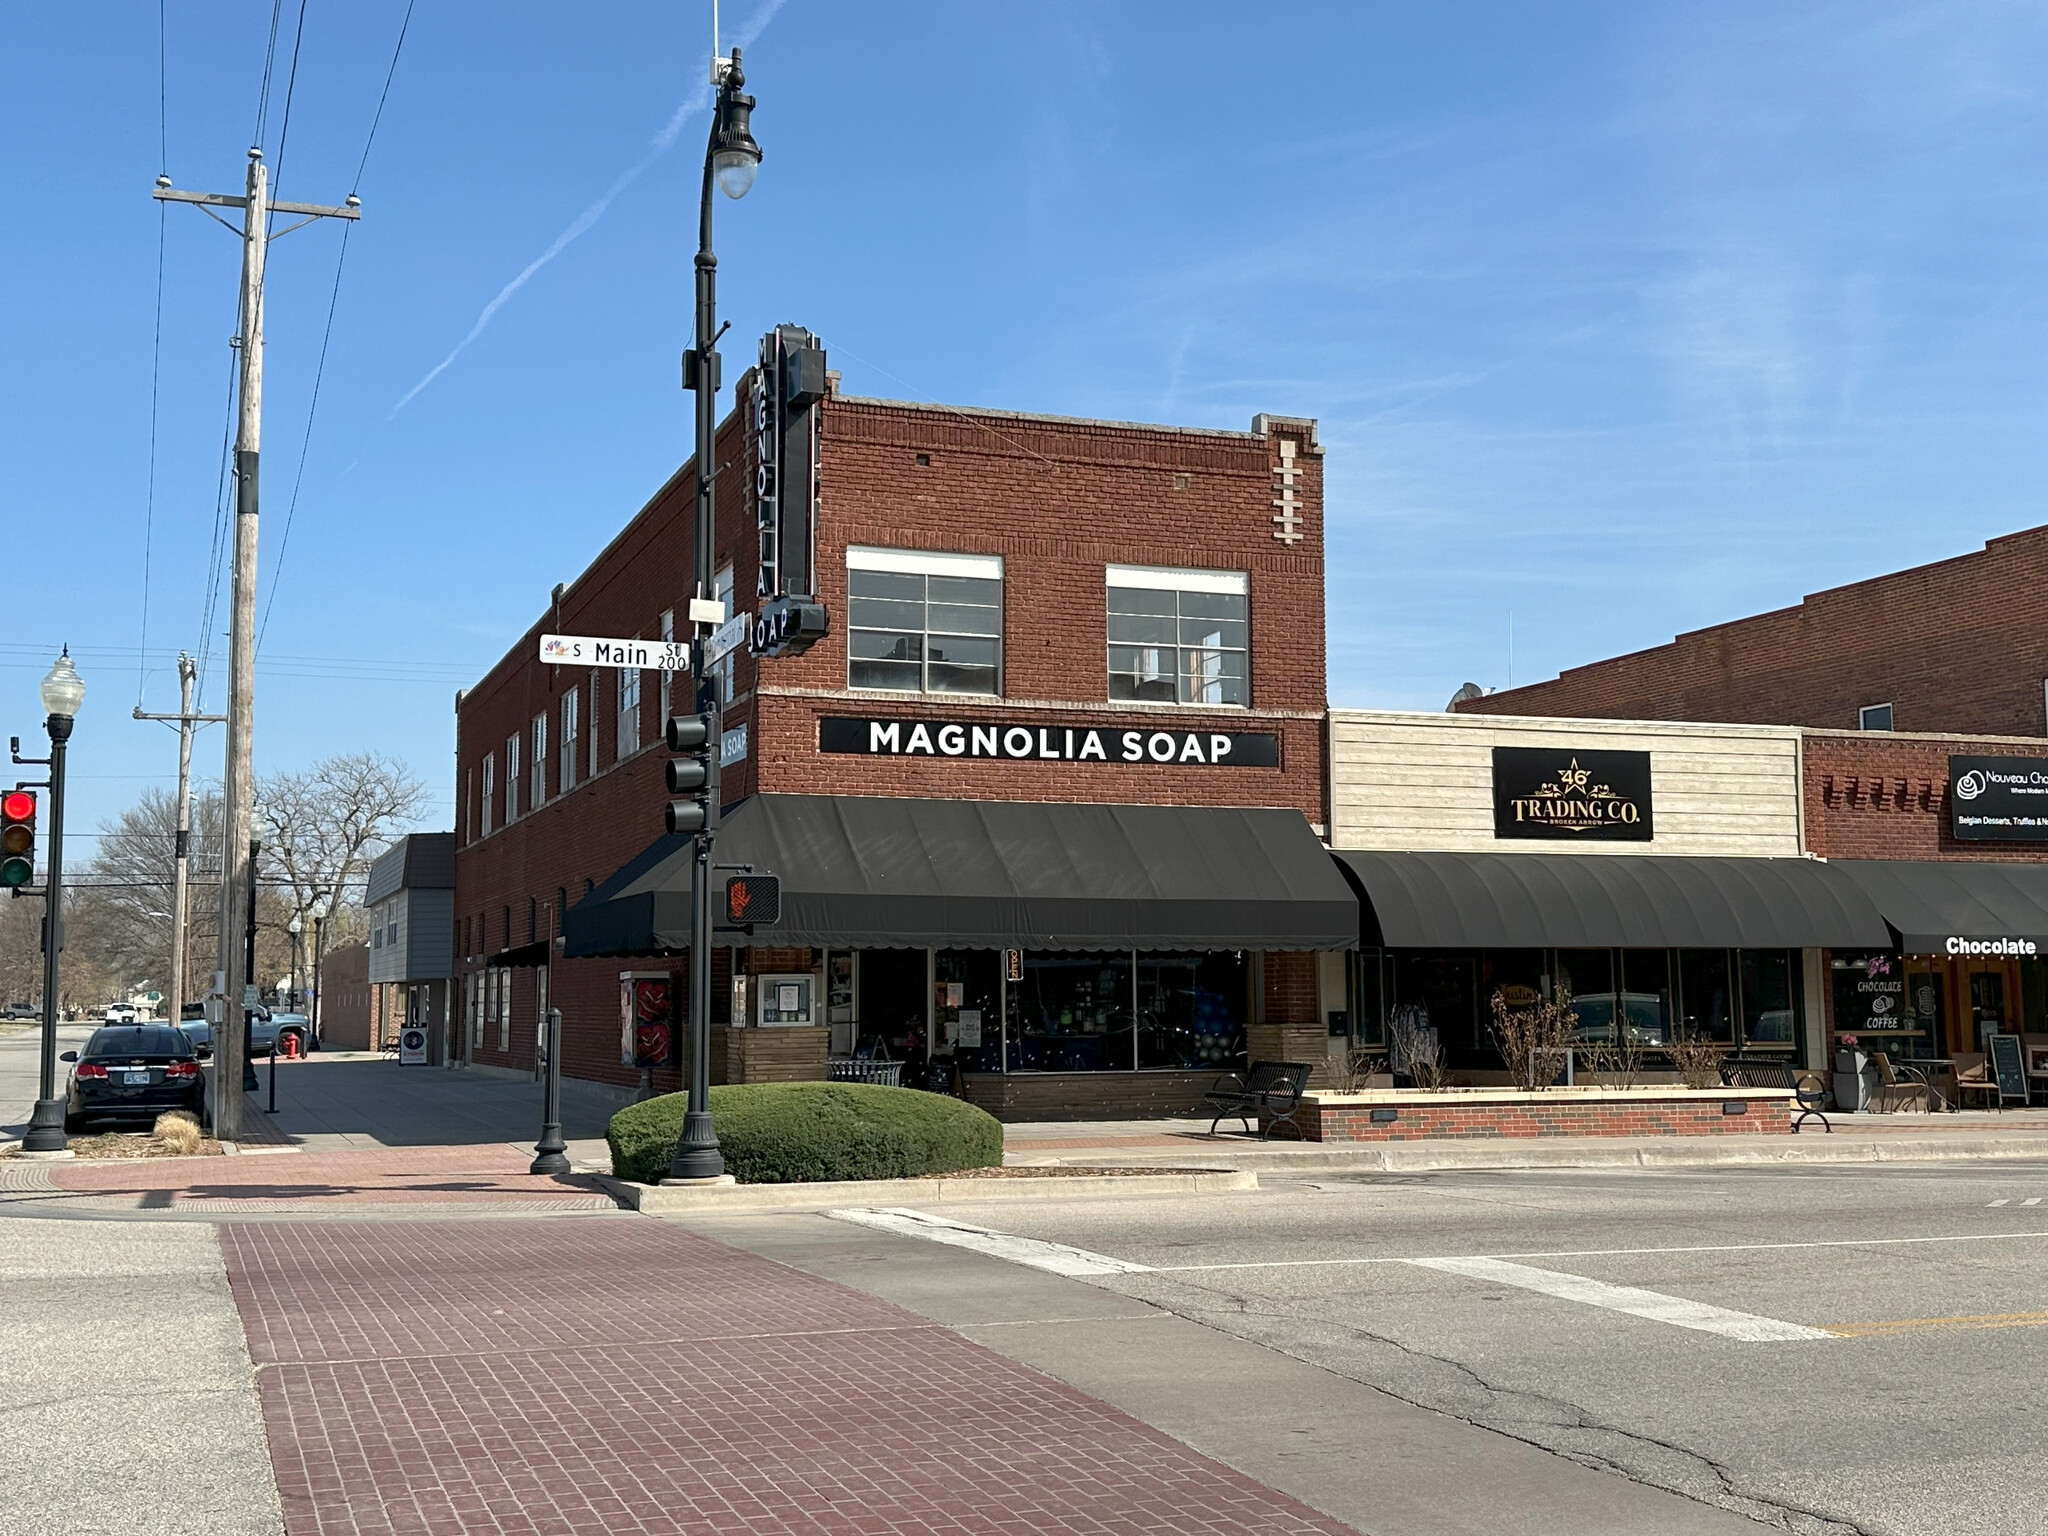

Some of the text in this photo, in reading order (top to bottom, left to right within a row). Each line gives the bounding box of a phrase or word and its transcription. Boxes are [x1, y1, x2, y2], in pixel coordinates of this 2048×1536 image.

[573, 643, 680, 665] S Main St
[658, 655, 687, 670] 200
[727, 732, 747, 757] SOAP
[870, 722, 1232, 763] MAGNOLIA SOAP
[1561, 769, 1588, 785] 46
[1986, 770, 2028, 784] Nouveau
[1511, 800, 1641, 824] TRADING CO.
[1958, 815, 1982, 826] Belgian
[2013, 816, 2036, 826] Truffles
[2036, 817, 2042, 826] &
[1946, 937, 2036, 955] Chocolate
[1010, 949, 1019, 979] OPEN
[1857, 981, 1902, 992] CHOCOLATE
[1866, 1017, 1898, 1029] COFFEE
